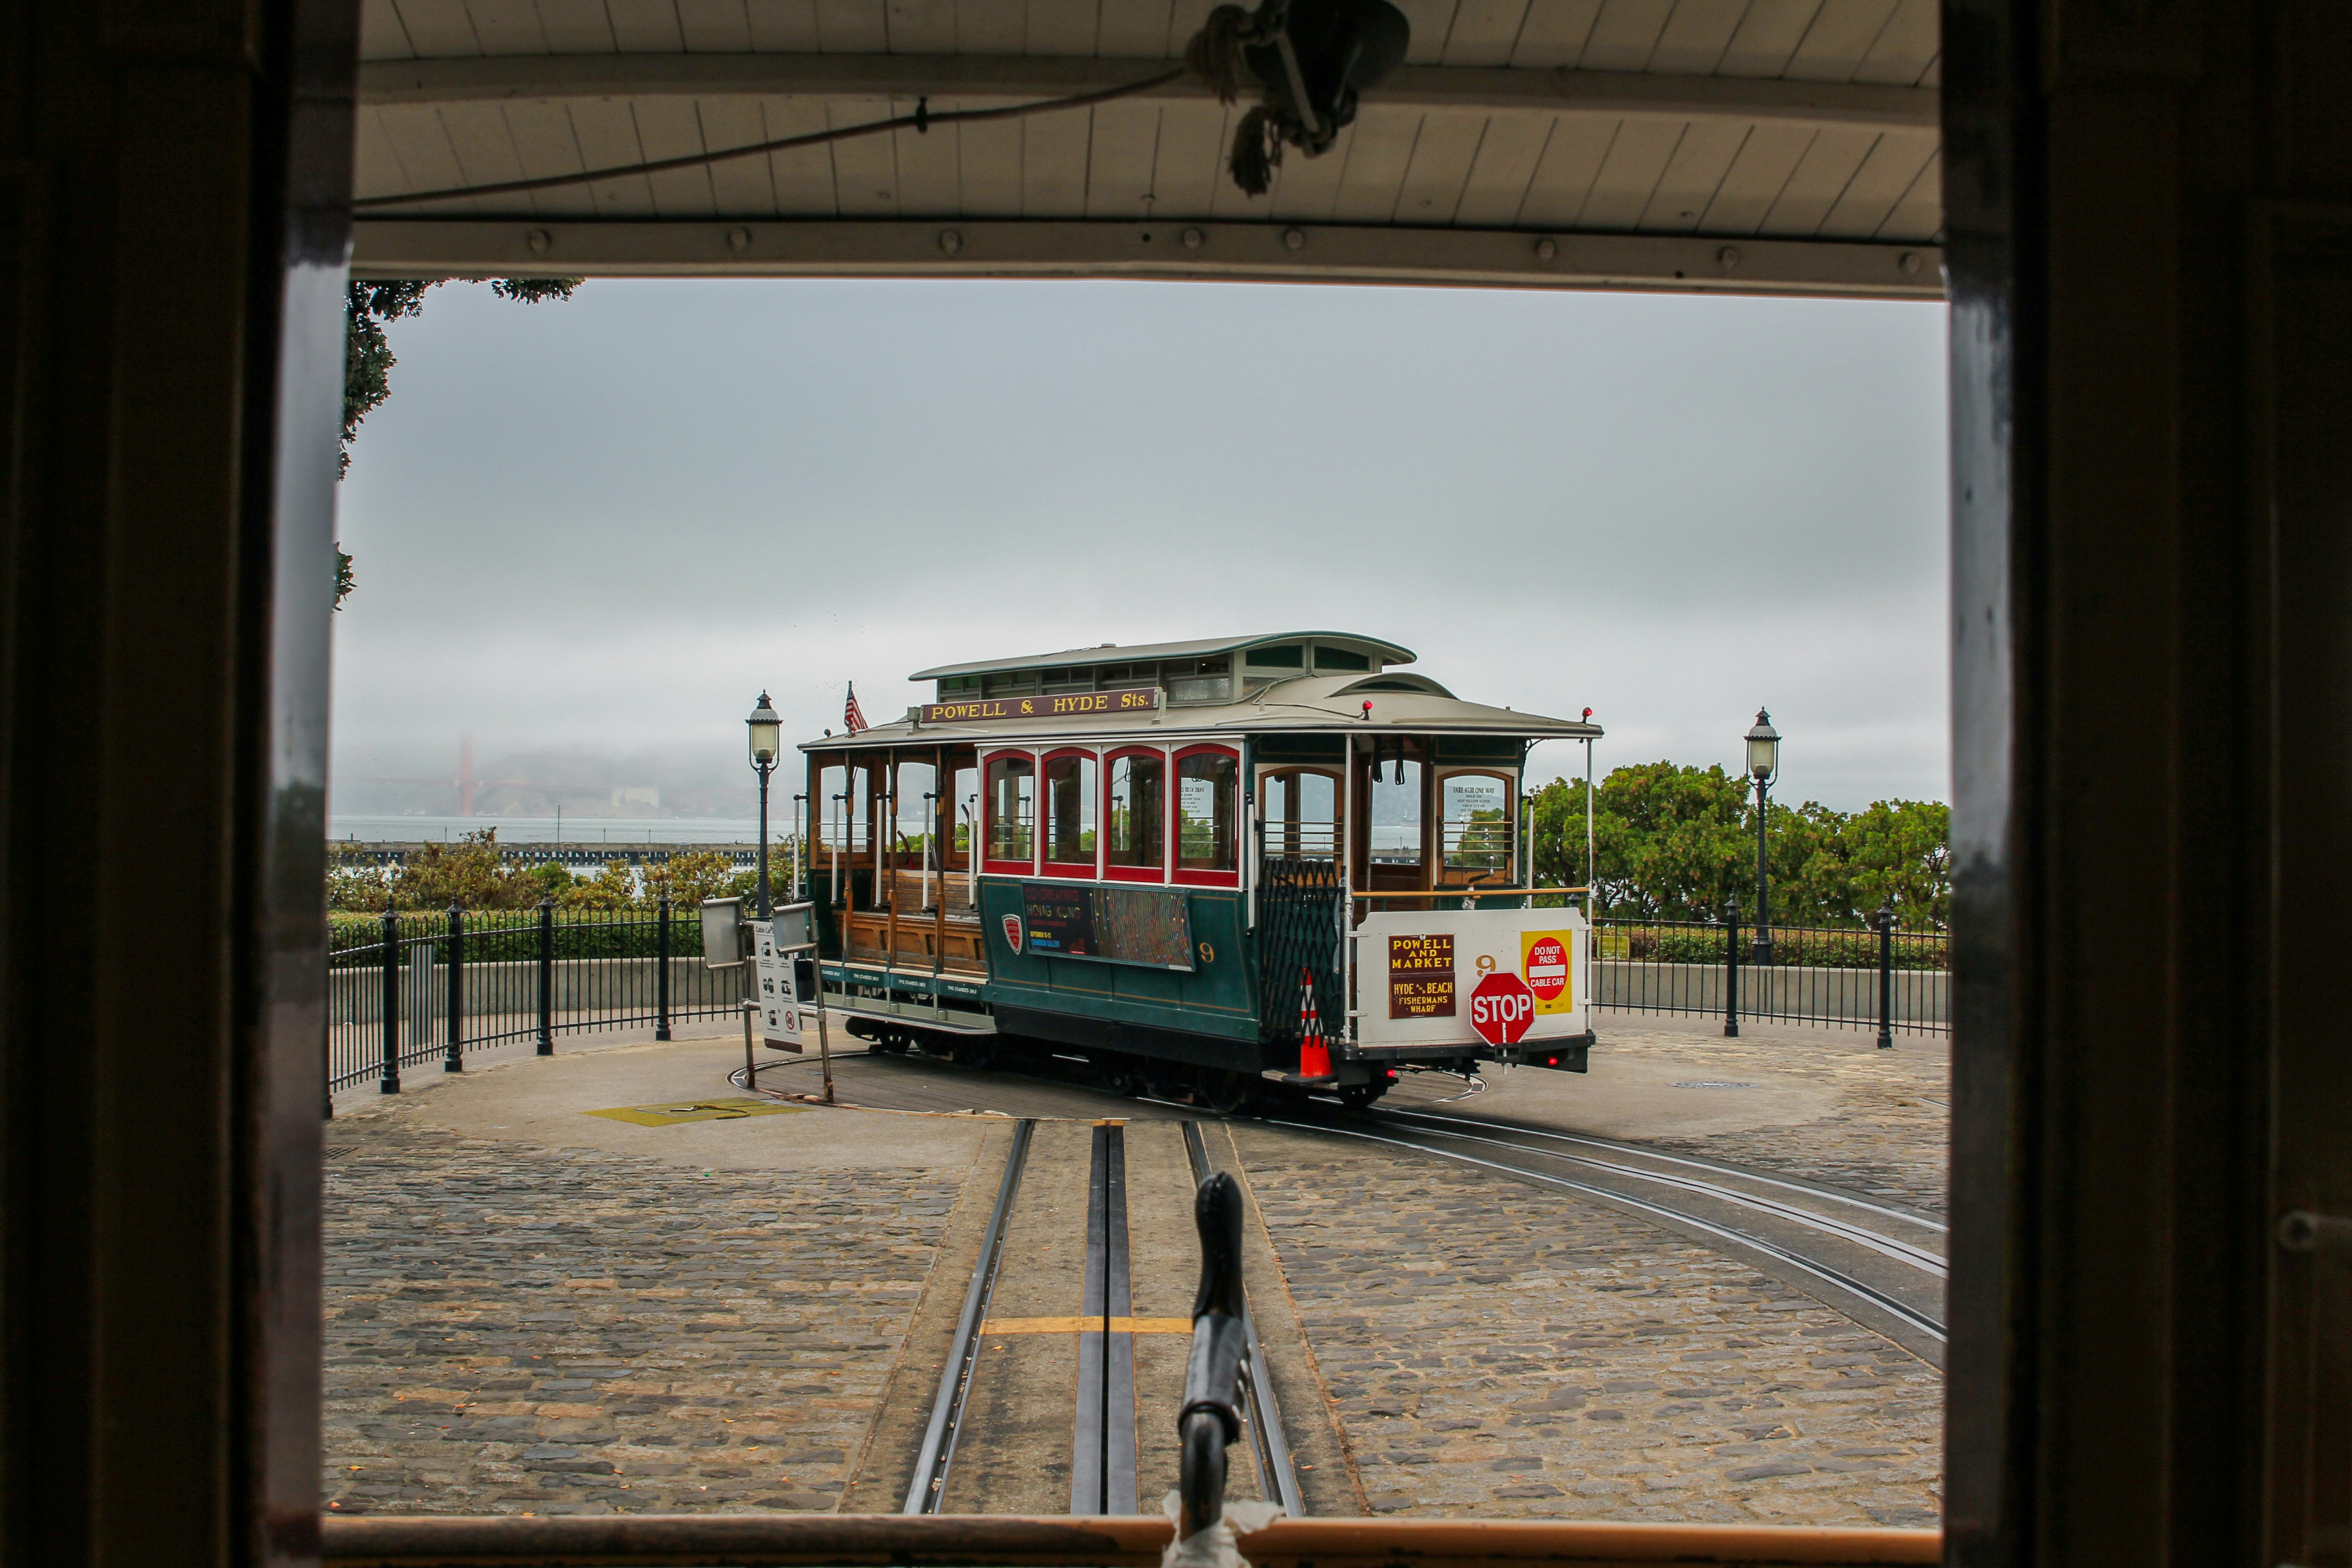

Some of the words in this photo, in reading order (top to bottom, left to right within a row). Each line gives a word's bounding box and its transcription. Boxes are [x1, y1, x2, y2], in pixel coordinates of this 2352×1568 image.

[931, 703, 1006, 720] POWELL
[1021, 700, 1034, 714] &
[1053, 696, 1108, 712] HYDE
[1121, 693, 1149, 708] Sts.
[1026, 904, 1052, 916] HONG
[1055, 906, 1081, 919] KONG
[1393, 939, 1450, 950] POWELL
[1200, 942, 1214, 962] 9
[1535, 947, 1545, 955] DO
[1546, 946, 1561, 955] NOT
[1392, 958, 1451, 968] MARKET
[1539, 955, 1557, 964] PASS
[1476, 955, 1496, 977] 9
[1531, 978, 1551, 987] CABLE
[1552, 977, 1564, 986] CAR
[1394, 984, 1414, 995] HYDE
[1427, 982, 1453, 994] BEACH
[1399, 996, 1448, 1004] FISHERMANS
[1411, 1004, 1436, 1013] WHARF
[1474, 994, 1531, 1024] STOP
